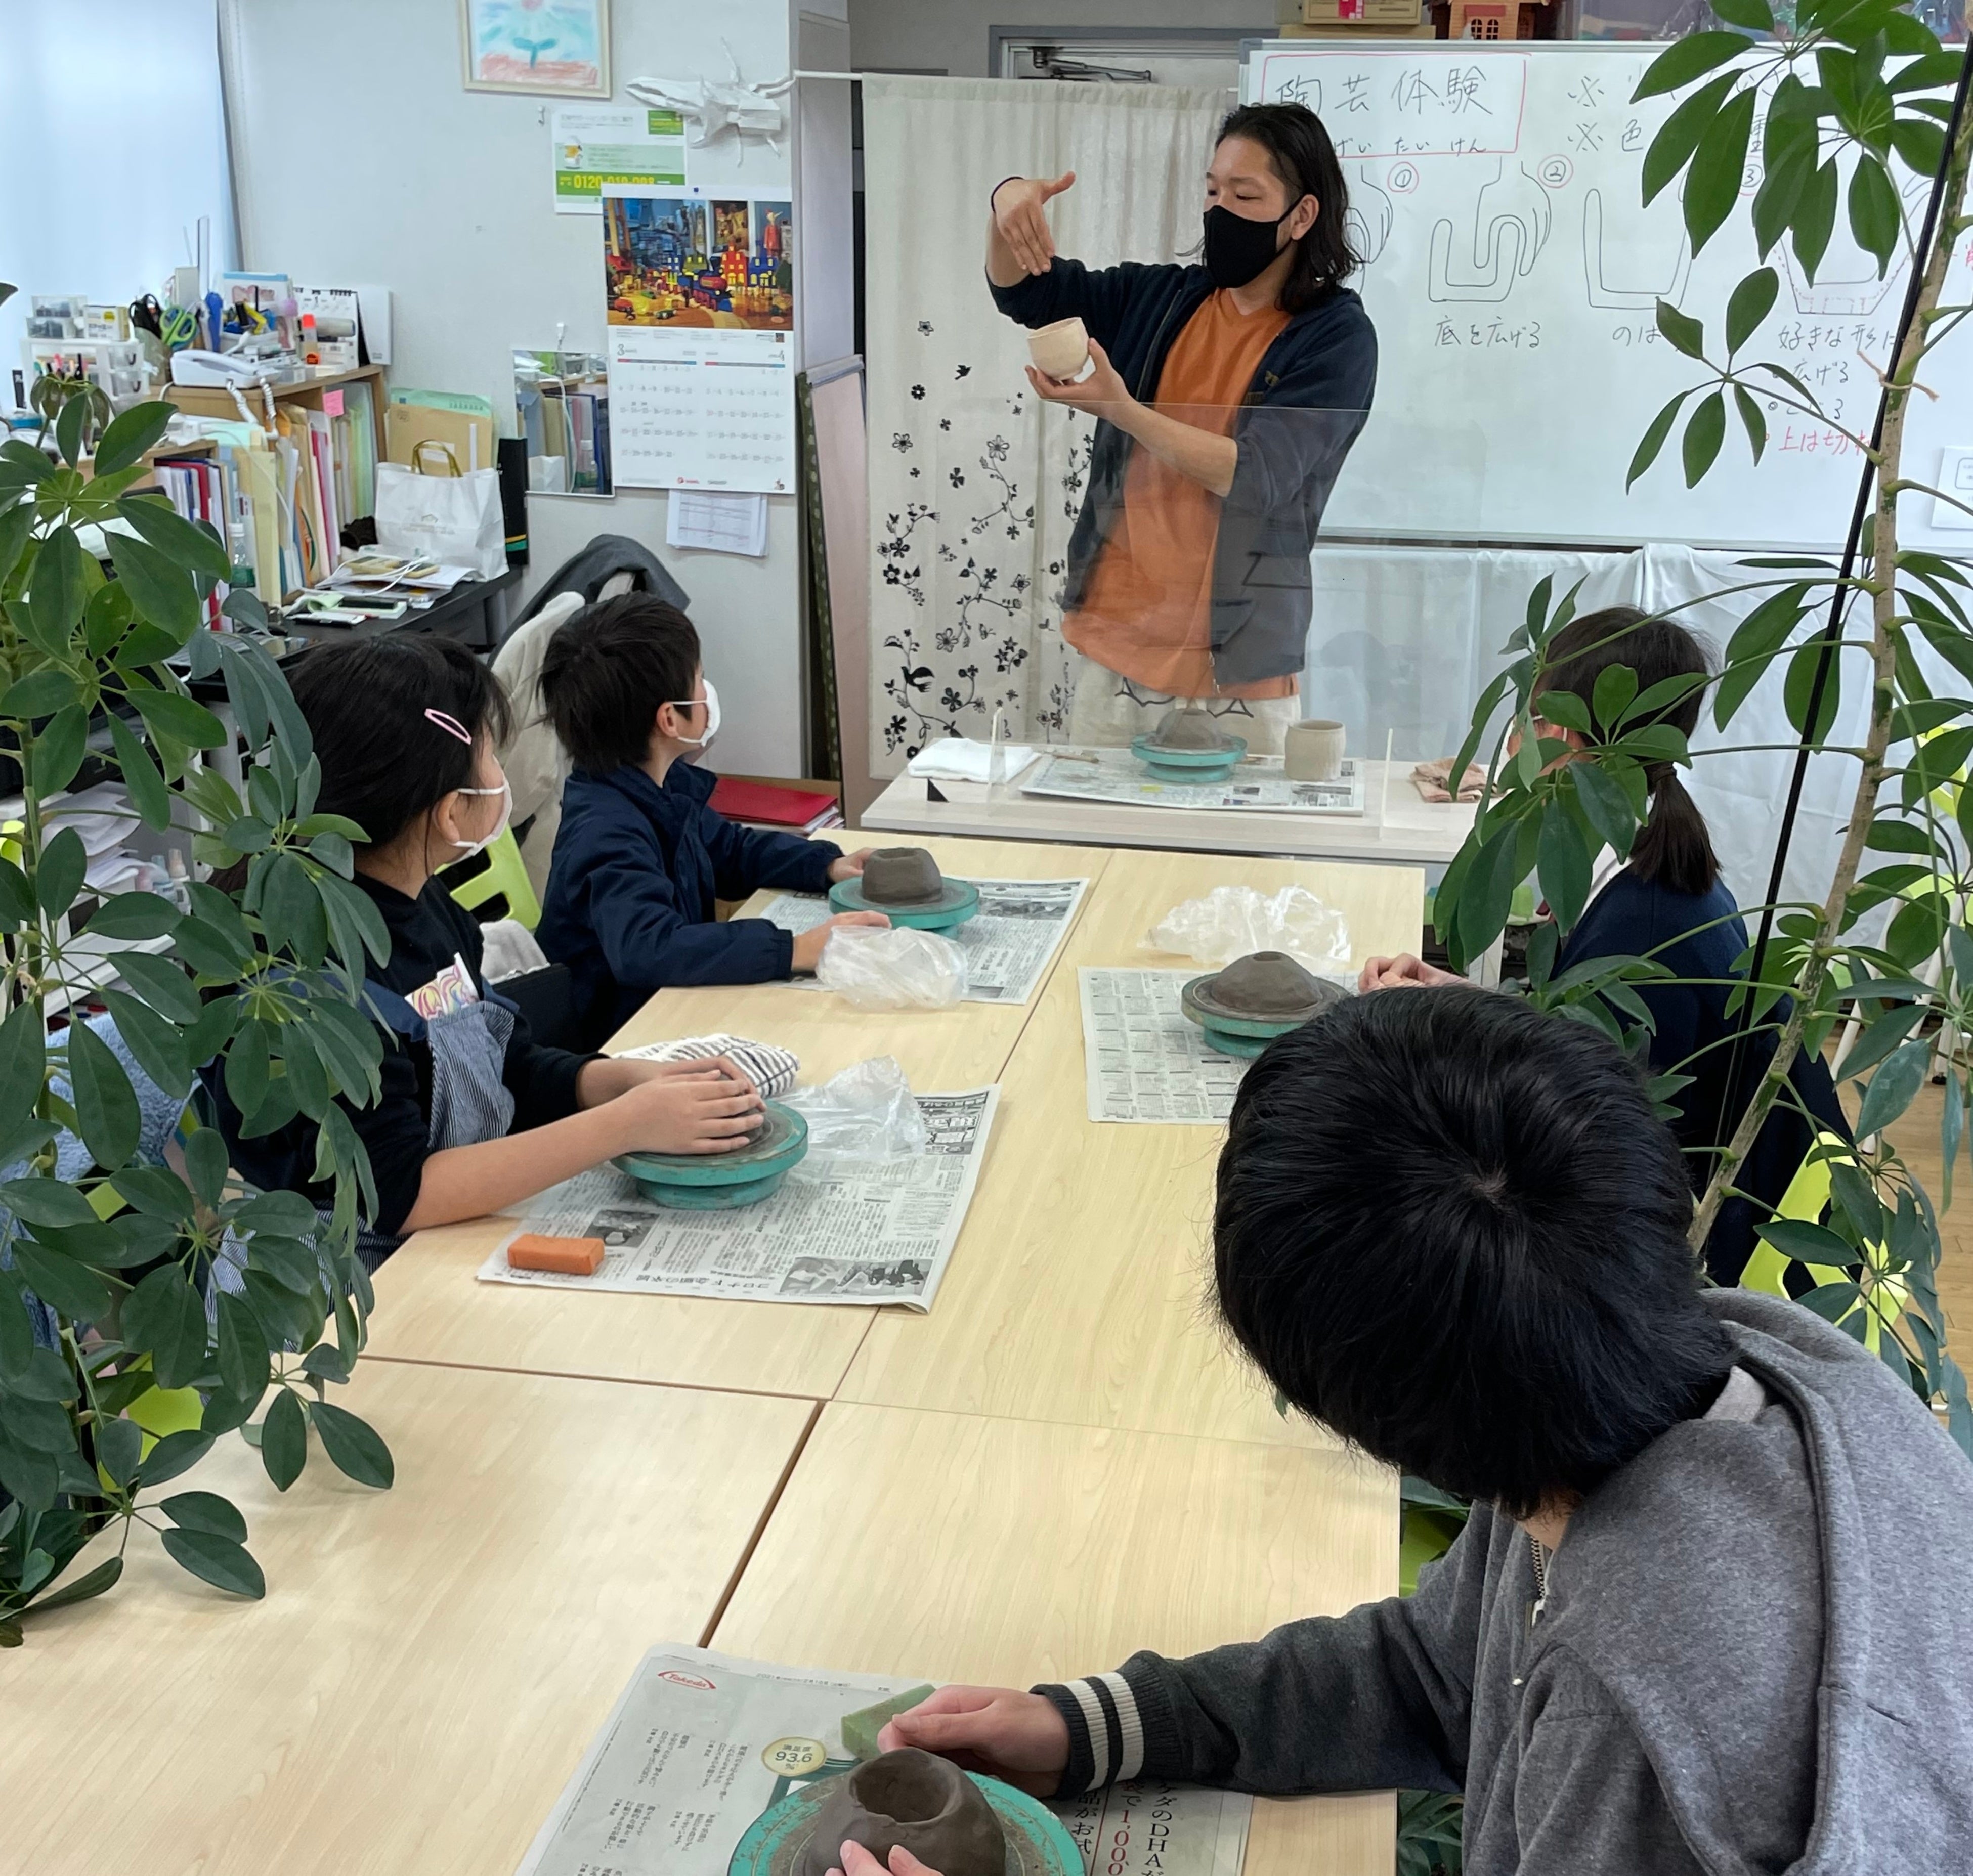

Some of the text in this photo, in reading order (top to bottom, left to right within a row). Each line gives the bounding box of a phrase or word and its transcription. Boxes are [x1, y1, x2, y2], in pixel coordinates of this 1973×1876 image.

[1275, 66, 1493, 115] 陶芸体験
[1435, 315, 1541, 348] 底を広げる
[668, 1673, 708, 1688] Takeda
[775, 1751, 813, 1763] 93.6
